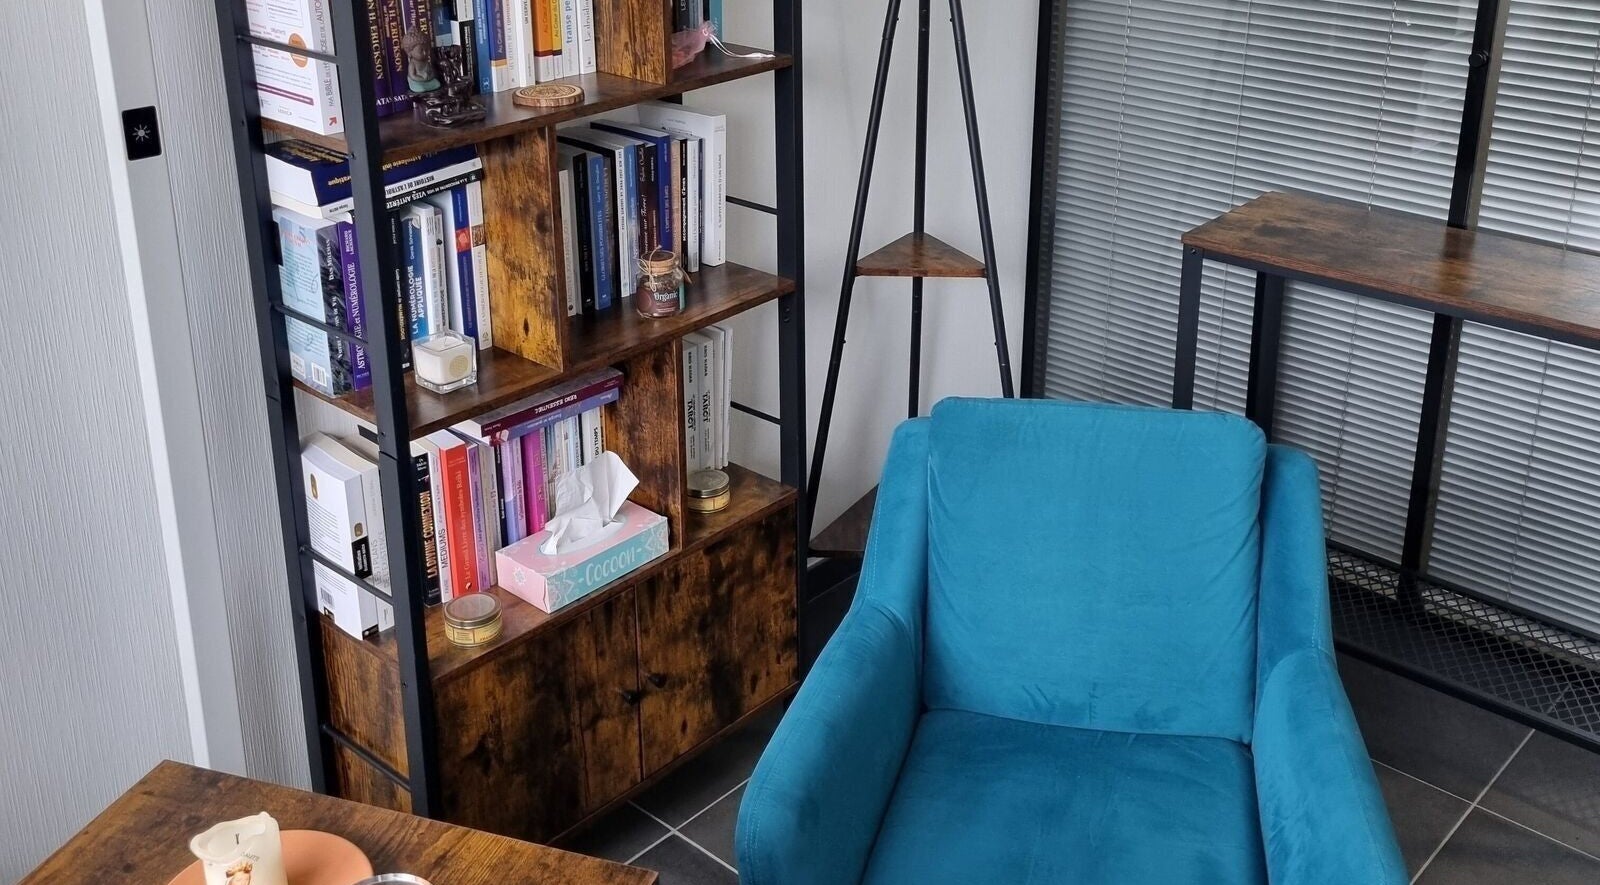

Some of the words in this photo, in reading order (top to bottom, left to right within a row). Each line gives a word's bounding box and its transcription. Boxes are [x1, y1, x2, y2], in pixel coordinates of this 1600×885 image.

[565, 14, 573, 43] transe
[370, 25, 385, 80] ERICKSON
[390, 23, 404, 72] ERICKSON
[324, 79, 333, 96] BIBLE
[375, 96, 393, 106] ATAS
[386, 196, 412, 209] ANTÉRIE
[411, 191, 427, 203] VIES
[348, 262, 360, 317] NUMÉROLOGIE
[409, 265, 417, 321] NUMÉROLOGIE
[417, 276, 425, 319] APPLIQUÉE
[412, 323, 419, 334] LA
[354, 323, 365, 369] ASTROGIE
[701, 394, 710, 423] TAROT
[420, 492, 434, 538] CONNEXION
[457, 489, 467, 519] symboles
[459, 519, 467, 530] des
[370, 539, 379, 565] PLANS
[424, 537, 436, 566] DIVINE
[438, 528, 448, 569] MEDIUMS
[460, 531, 468, 550] Livre
[428, 566, 438, 579] LA
[462, 550, 470, 570] Grand
[464, 570, 471, 580] Le
